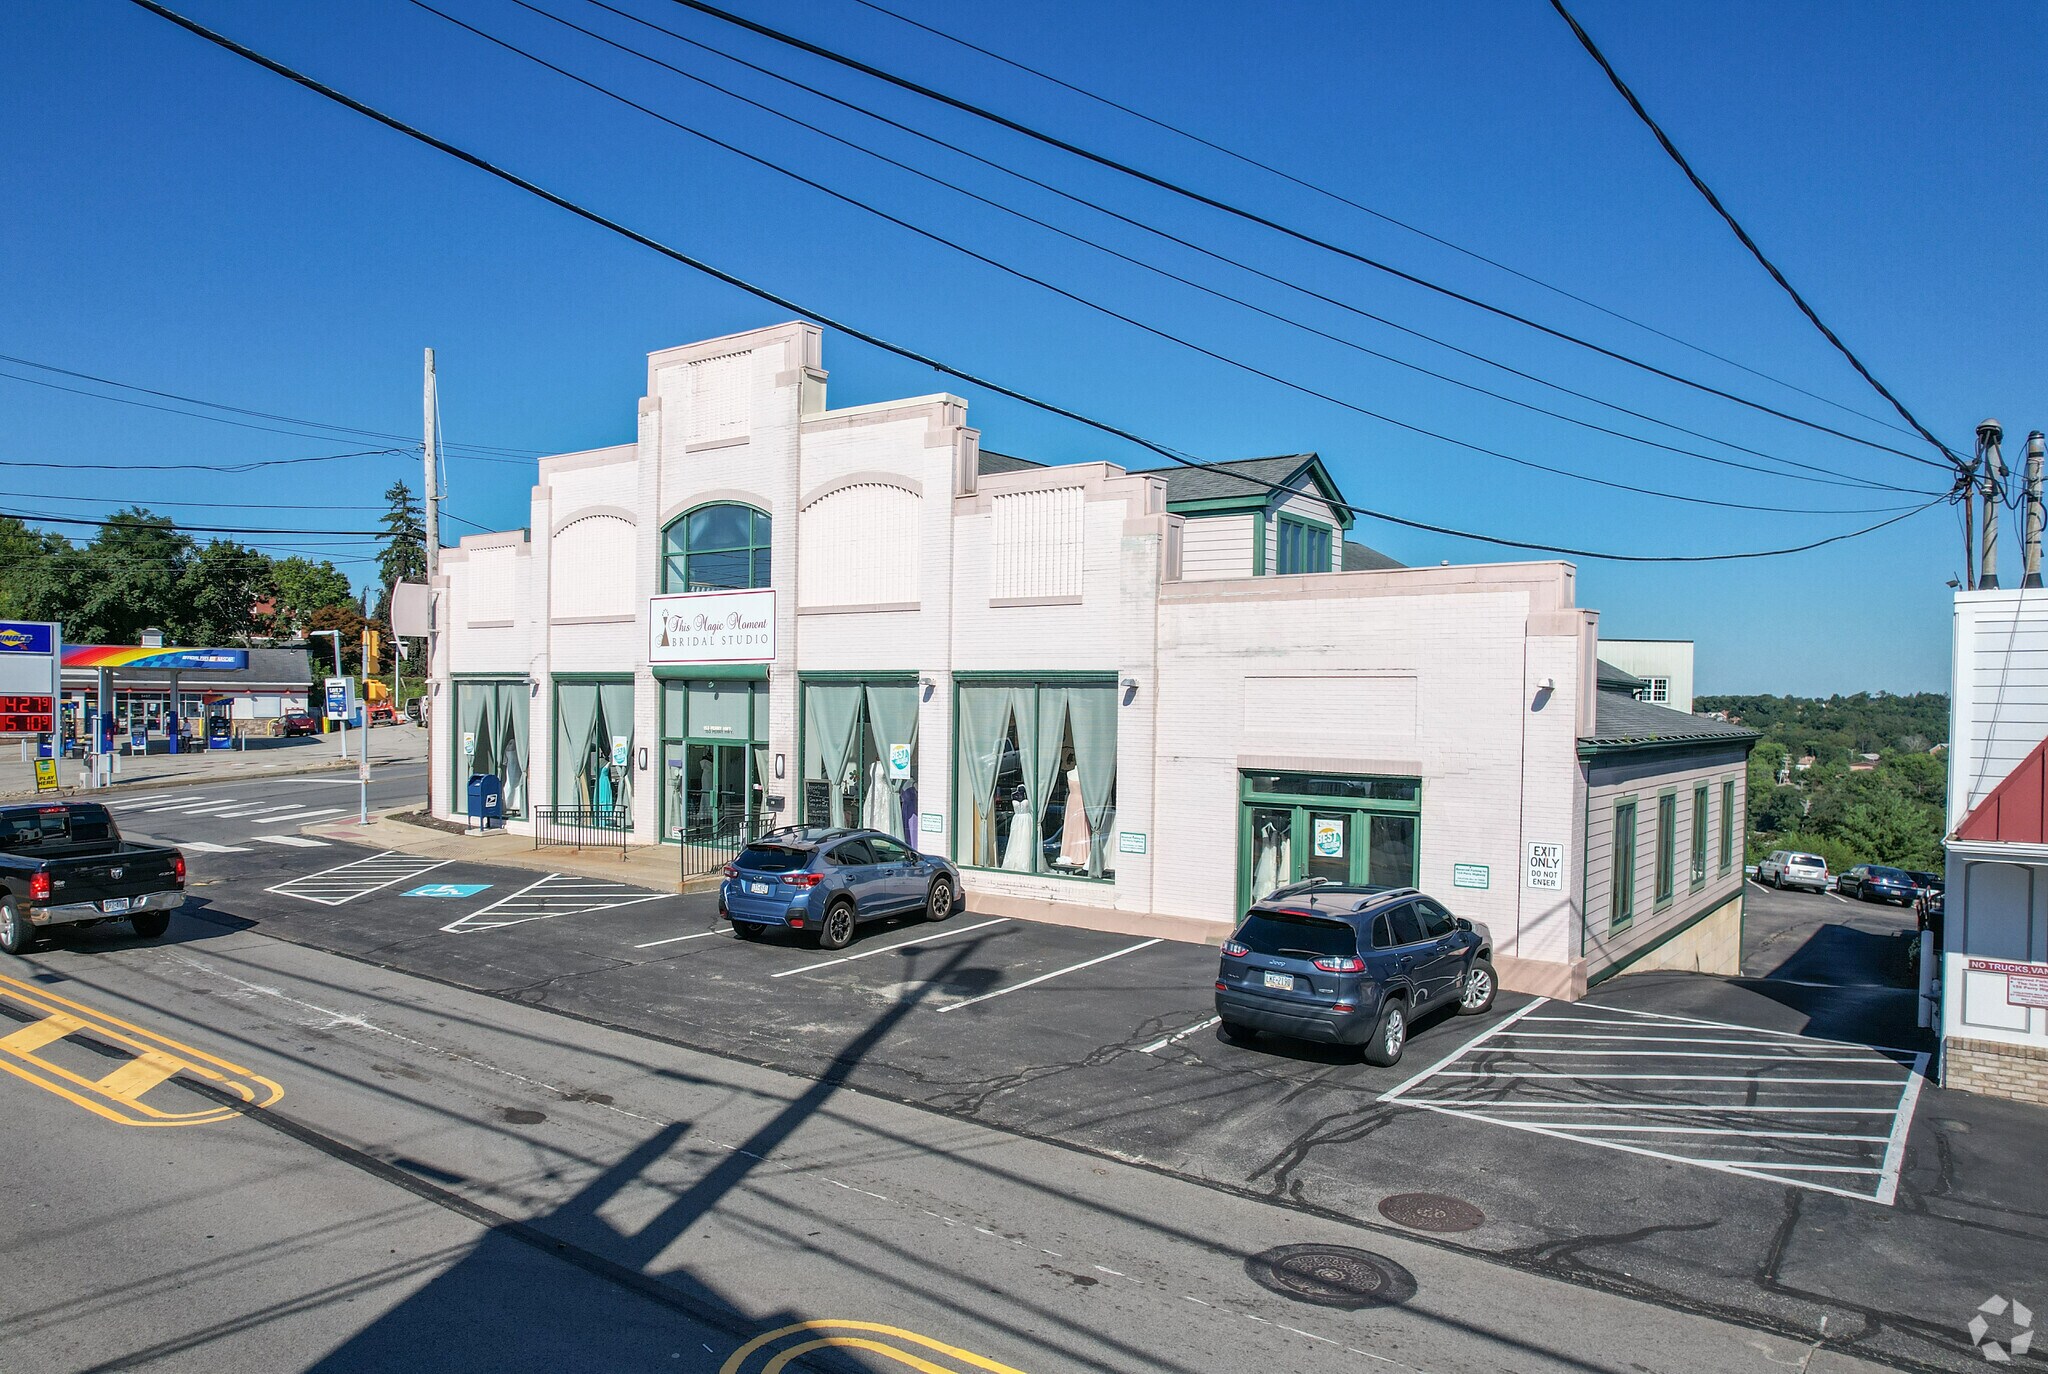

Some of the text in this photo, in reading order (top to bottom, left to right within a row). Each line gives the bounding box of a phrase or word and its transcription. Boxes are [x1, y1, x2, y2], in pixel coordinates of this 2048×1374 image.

[668, 612, 768, 634] This Magic Moment
[672, 634, 768, 646] BRIDAL STUDIO
[1318, 832, 1337, 844] BEST
[1534, 846, 1558, 858] EXIT
[1530, 857, 1560, 868] ONLY
[1544, 870, 1558, 878] NOT
[1532, 878, 1556, 887] ENTER
